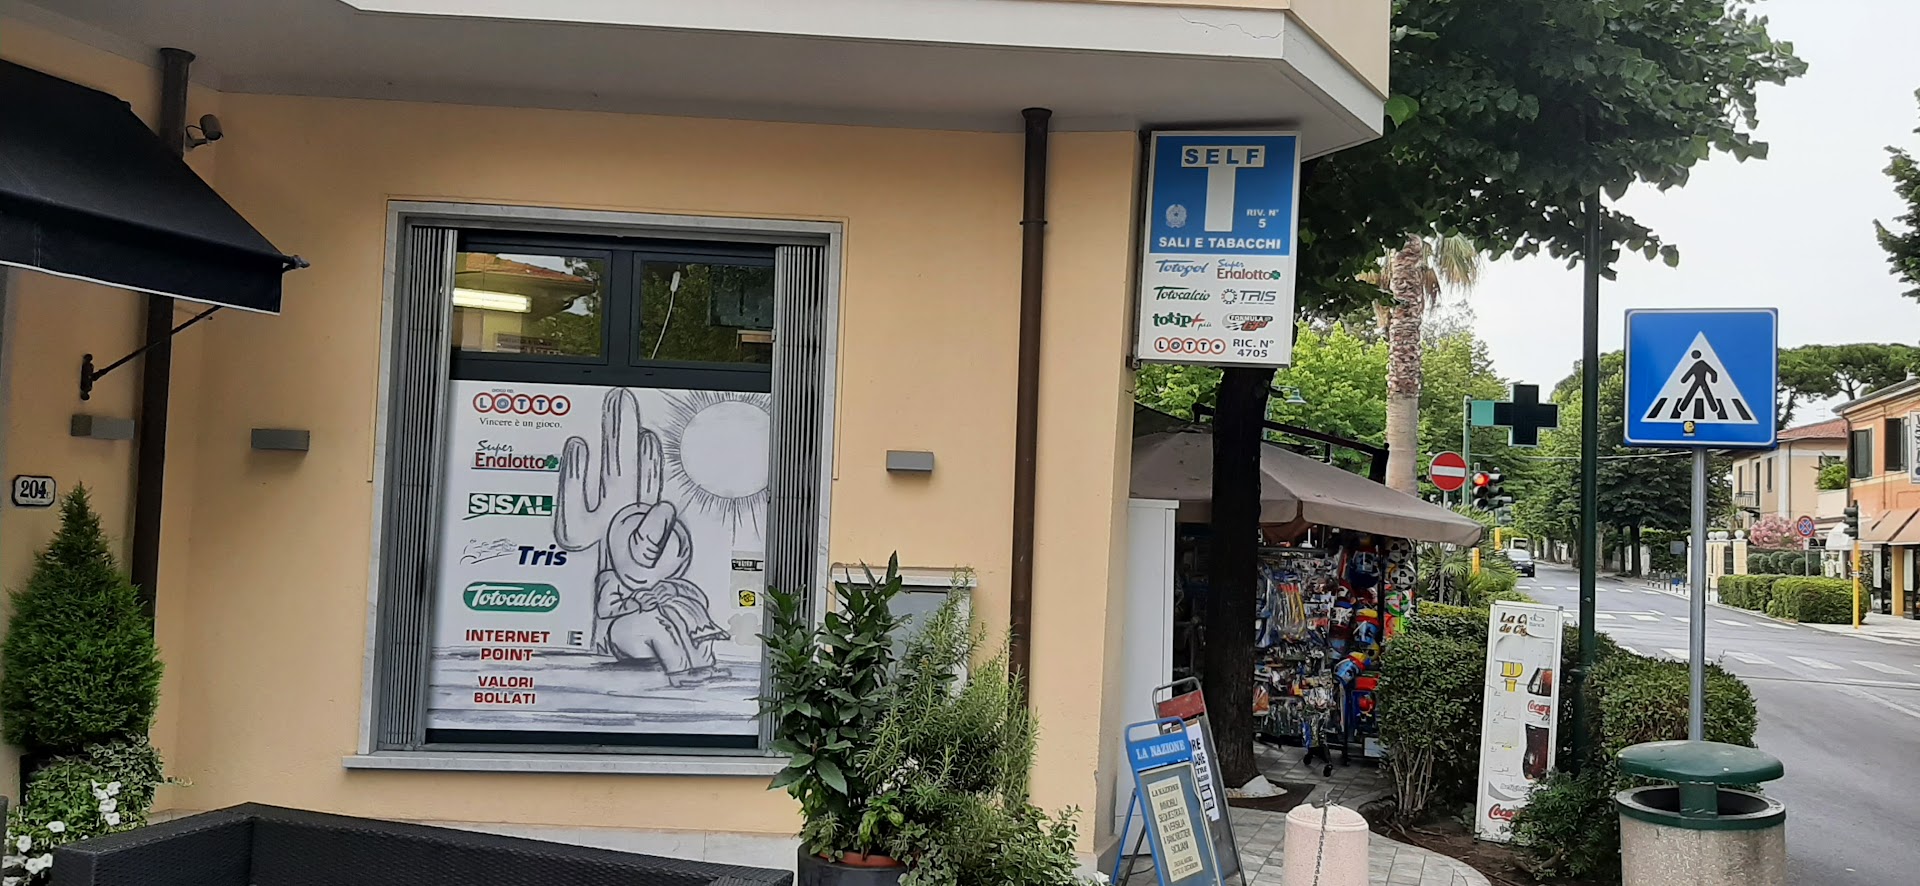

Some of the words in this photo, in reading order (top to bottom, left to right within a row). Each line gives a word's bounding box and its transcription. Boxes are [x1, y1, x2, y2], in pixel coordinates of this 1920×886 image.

[1184, 148, 1260, 165] SELF
[1246, 208, 1266, 217] RIV.
[1258, 218, 1267, 228] 5
[1158, 236, 1190, 248] SALI
[1194, 237, 1204, 248] E
[1208, 238, 1281, 250] TABACCHI
[1155, 259, 1209, 277] Totogol
[1217, 259, 1244, 270] Super
[1217, 268, 1272, 280] Enalotto
[1153, 286, 1211, 301] Totocalcio
[1240, 290, 1277, 302] TRIS
[1154, 337, 1226, 354] LOTTO
[1232, 338, 1256, 348] RIC.
[1237, 349, 1268, 358] 4705
[473, 392, 571, 416] LOTTO
[480, 417, 513, 427] Vincere
[515, 419, 520, 427] è
[477, 440, 514, 456] Super
[475, 452, 546, 470] Enalotto
[20, 480, 47, 499] 204
[469, 494, 552, 515] SISAL
[518, 544, 567, 566] Tris
[467, 584, 557, 608] Totocalcio
[466, 629, 550, 643] INTERNET
[481, 648, 534, 661] POINT
[478, 675, 534, 688] VALORI
[474, 692, 536, 704] BOLLATI
[1136, 747, 1149, 760] LA
[1149, 740, 1186, 757] NAZIONE
